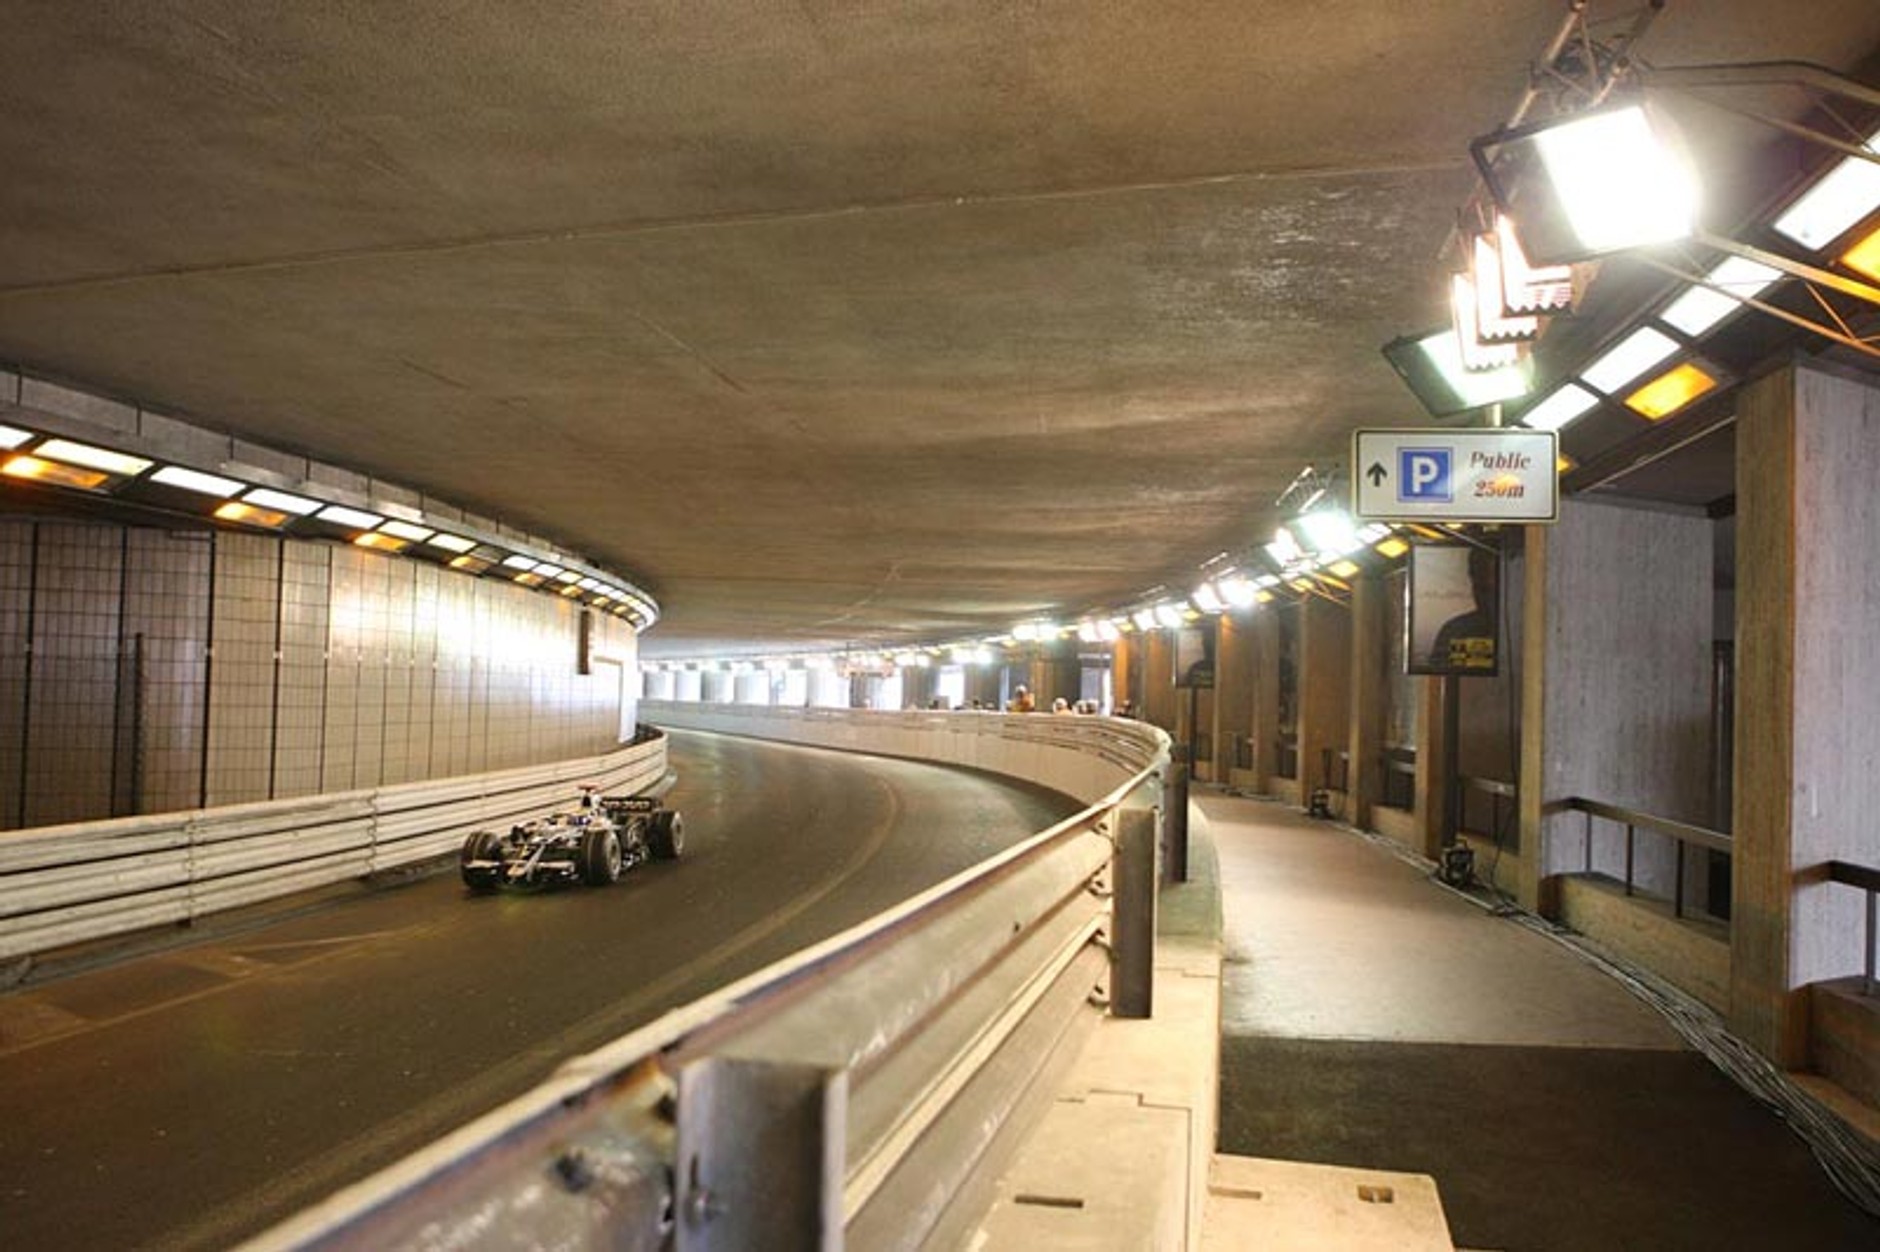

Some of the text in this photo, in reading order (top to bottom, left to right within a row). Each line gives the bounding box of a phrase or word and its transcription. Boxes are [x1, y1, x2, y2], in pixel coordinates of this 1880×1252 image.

[1470, 451, 1531, 469] Public
[1411, 455, 1439, 494] P
[1473, 479, 1525, 498] 250m
